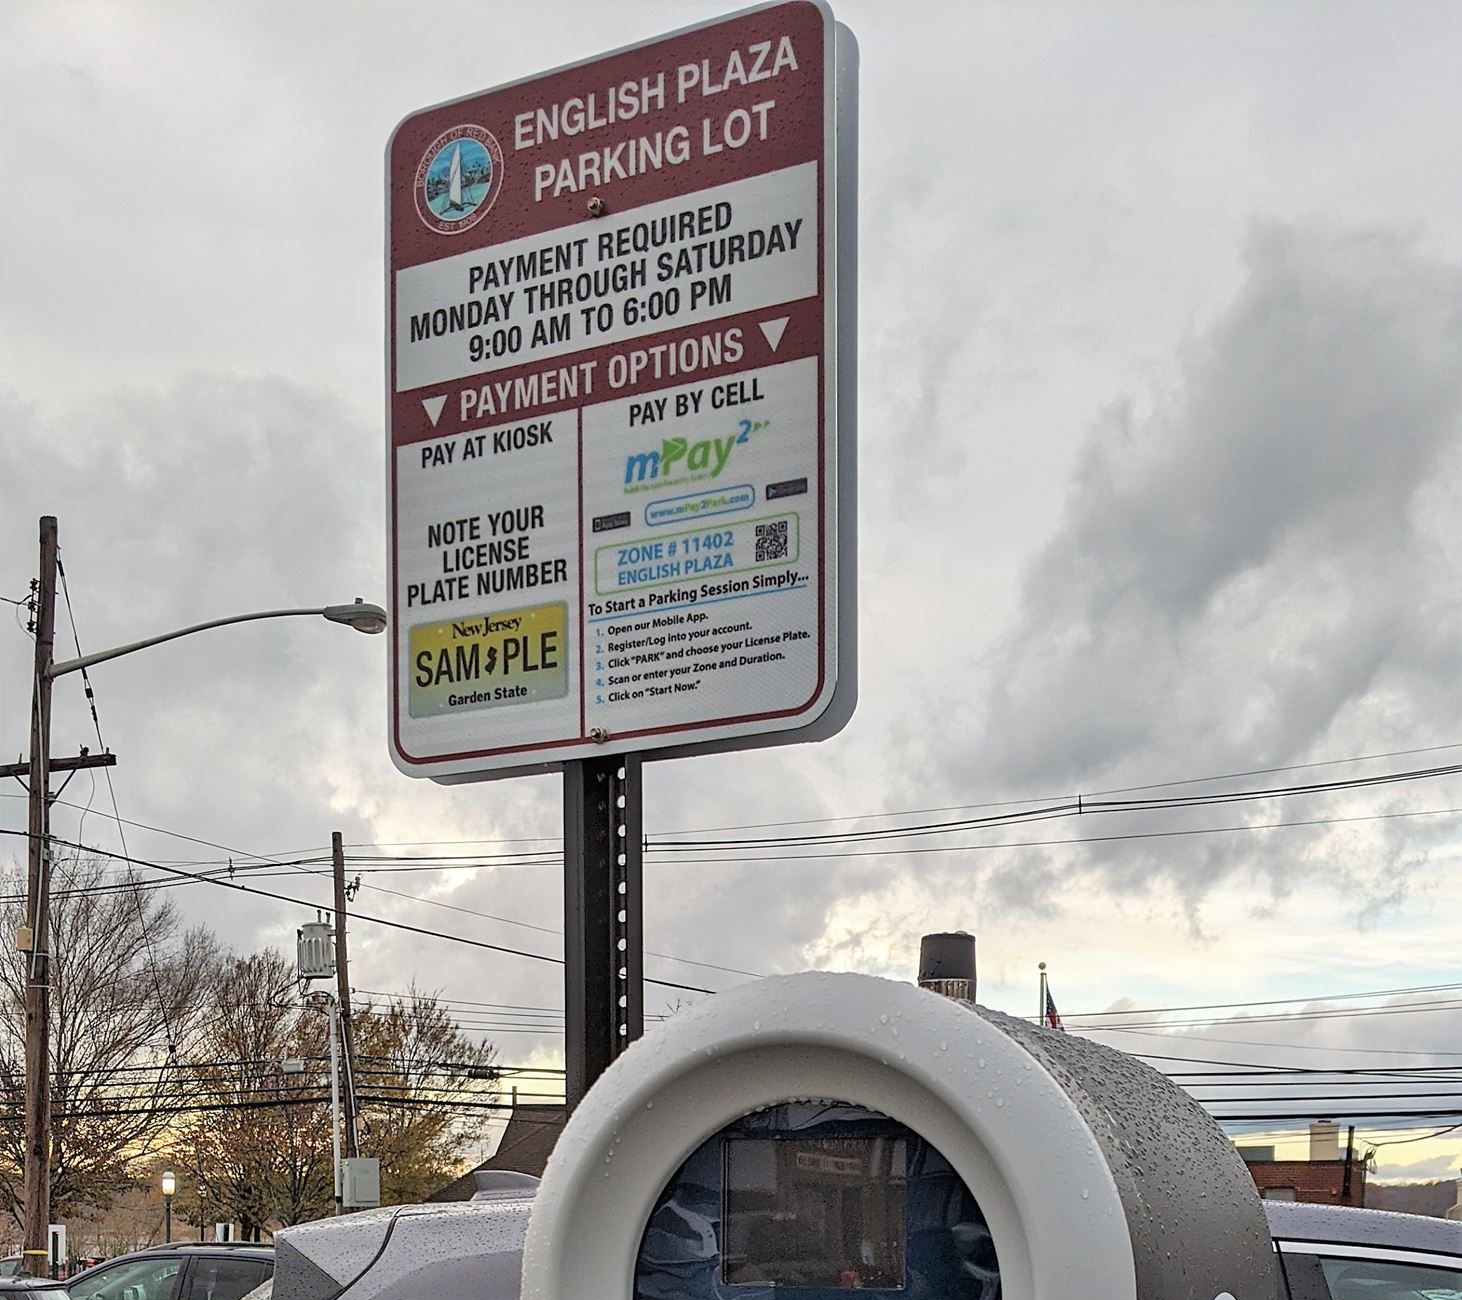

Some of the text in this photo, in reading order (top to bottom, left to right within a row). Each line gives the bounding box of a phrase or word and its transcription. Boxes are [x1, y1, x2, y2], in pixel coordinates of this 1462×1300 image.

[513, 35, 799, 151] ENGLISH PLAZA
[416, 127, 502, 188] BOROUGH OF RED BANK
[534, 100, 776, 203] PARKING LOT
[438, 221, 455, 231] EST
[468, 201, 733, 294] PAYMENT REQUIRED
[409, 218, 804, 343] MONDAY THROUGH SATURDAY
[468, 273, 733, 363] 9:00 AM TO 6:00 PM
[459, 327, 744, 422] PAYMENT OPTIONS
[628, 376, 765, 427] PAY BY CELL
[420, 421, 554, 469] PAY AT KIOSK
[427, 505, 544, 549] NOTE YOUR
[617, 530, 734, 567] ZONE # 11402
[442, 536, 530, 574] LICENSE
[618, 552, 734, 586] ENGLISH PLAZA
[406, 558, 568, 608] PLATE NUMBER
[588, 569, 810, 616] To Start a Parking Session Simply...
[452, 616, 522, 639] New Jersey
[596, 611, 709, 638] 1. Open our Mobile App.
[596, 621, 753, 654] 2. Register/Log into your account.
[607, 656, 630, 670] Click
[665, 649, 685, 661] and
[685, 644, 720, 658] choose
[720, 640, 744, 654] your
[744, 634, 782, 648] License
[782, 629, 811, 643] Plate.
[607, 674, 631, 687] Scan
[631, 673, 643, 682] or
[643, 669, 669, 681] enter
[669, 666, 692, 680] your
[692, 661, 718, 673] Zone
[718, 657, 738, 669] and
[738, 651, 786, 666] Duration.
[448, 685, 528, 707] Garden State
[607, 690, 631, 703] Click
[631, 689, 645, 699] on
